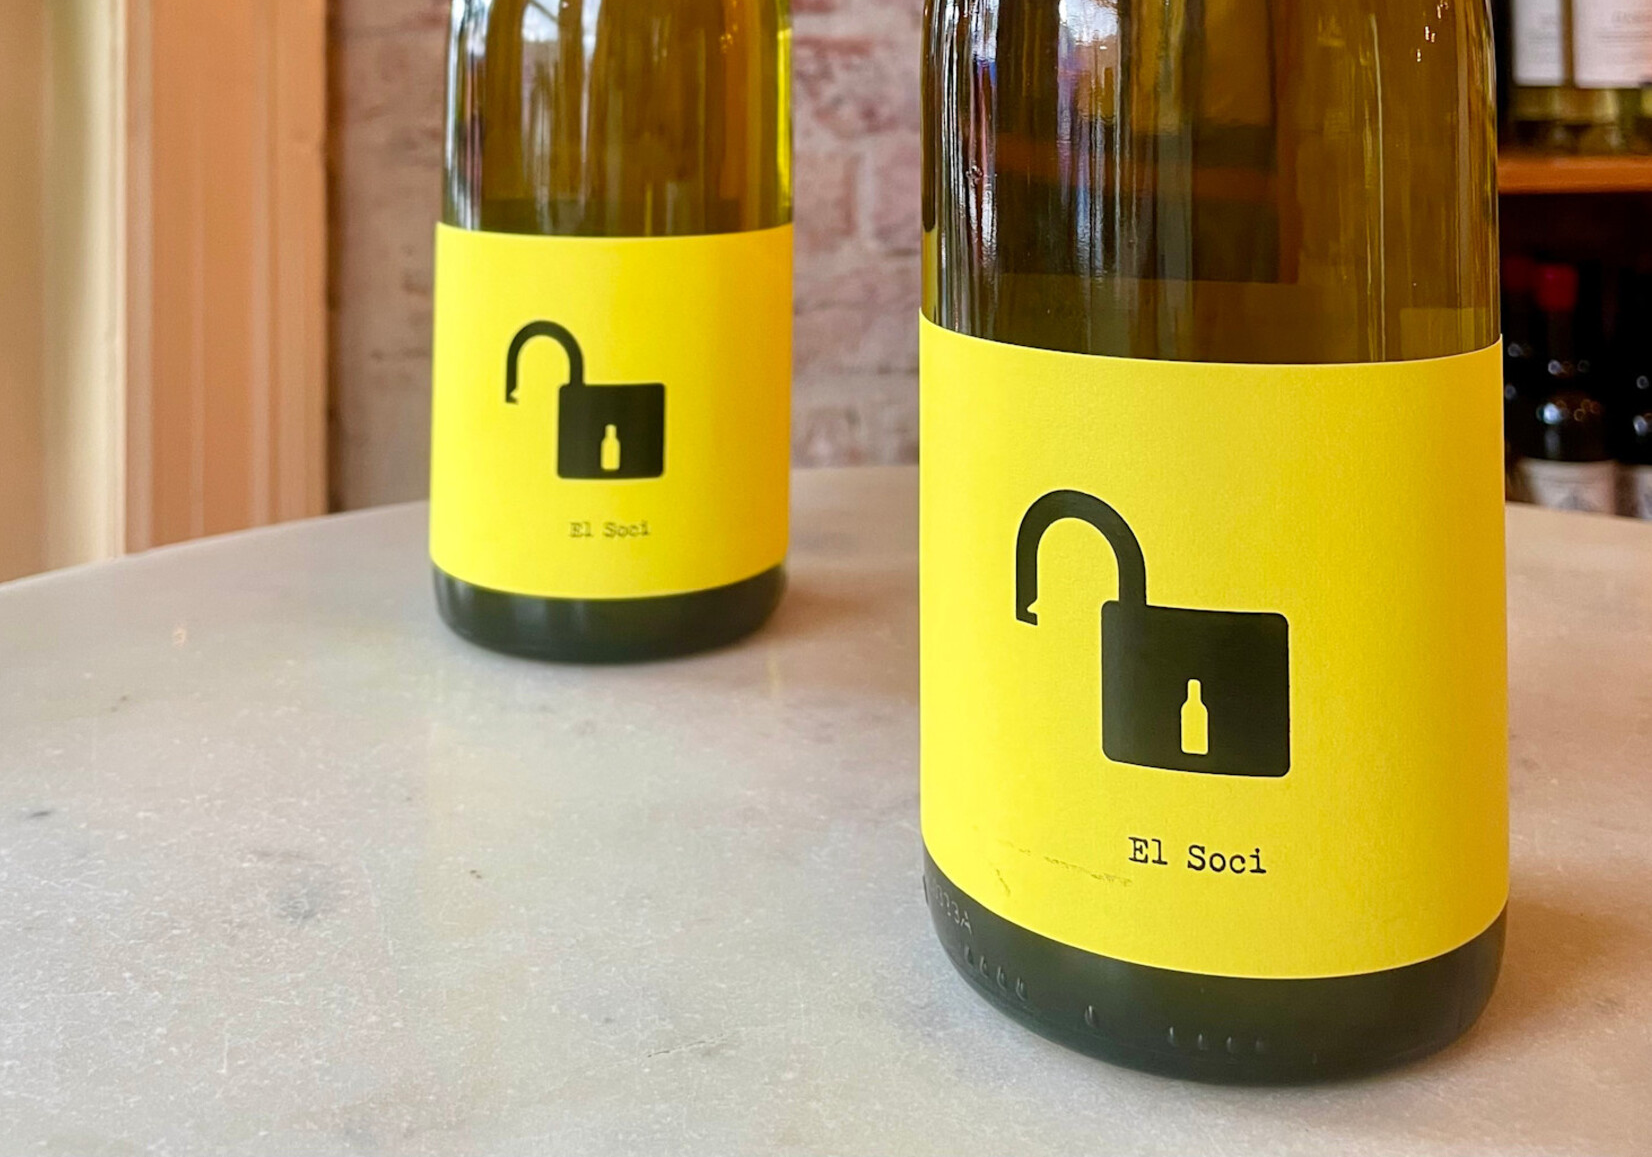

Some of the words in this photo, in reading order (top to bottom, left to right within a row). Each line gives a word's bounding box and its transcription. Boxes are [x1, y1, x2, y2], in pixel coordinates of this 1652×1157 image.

[569, 521, 593, 538] El
[603, 520, 650, 538] Soci
[1128, 836, 1168, 865] El
[1187, 844, 1267, 874] Soci
